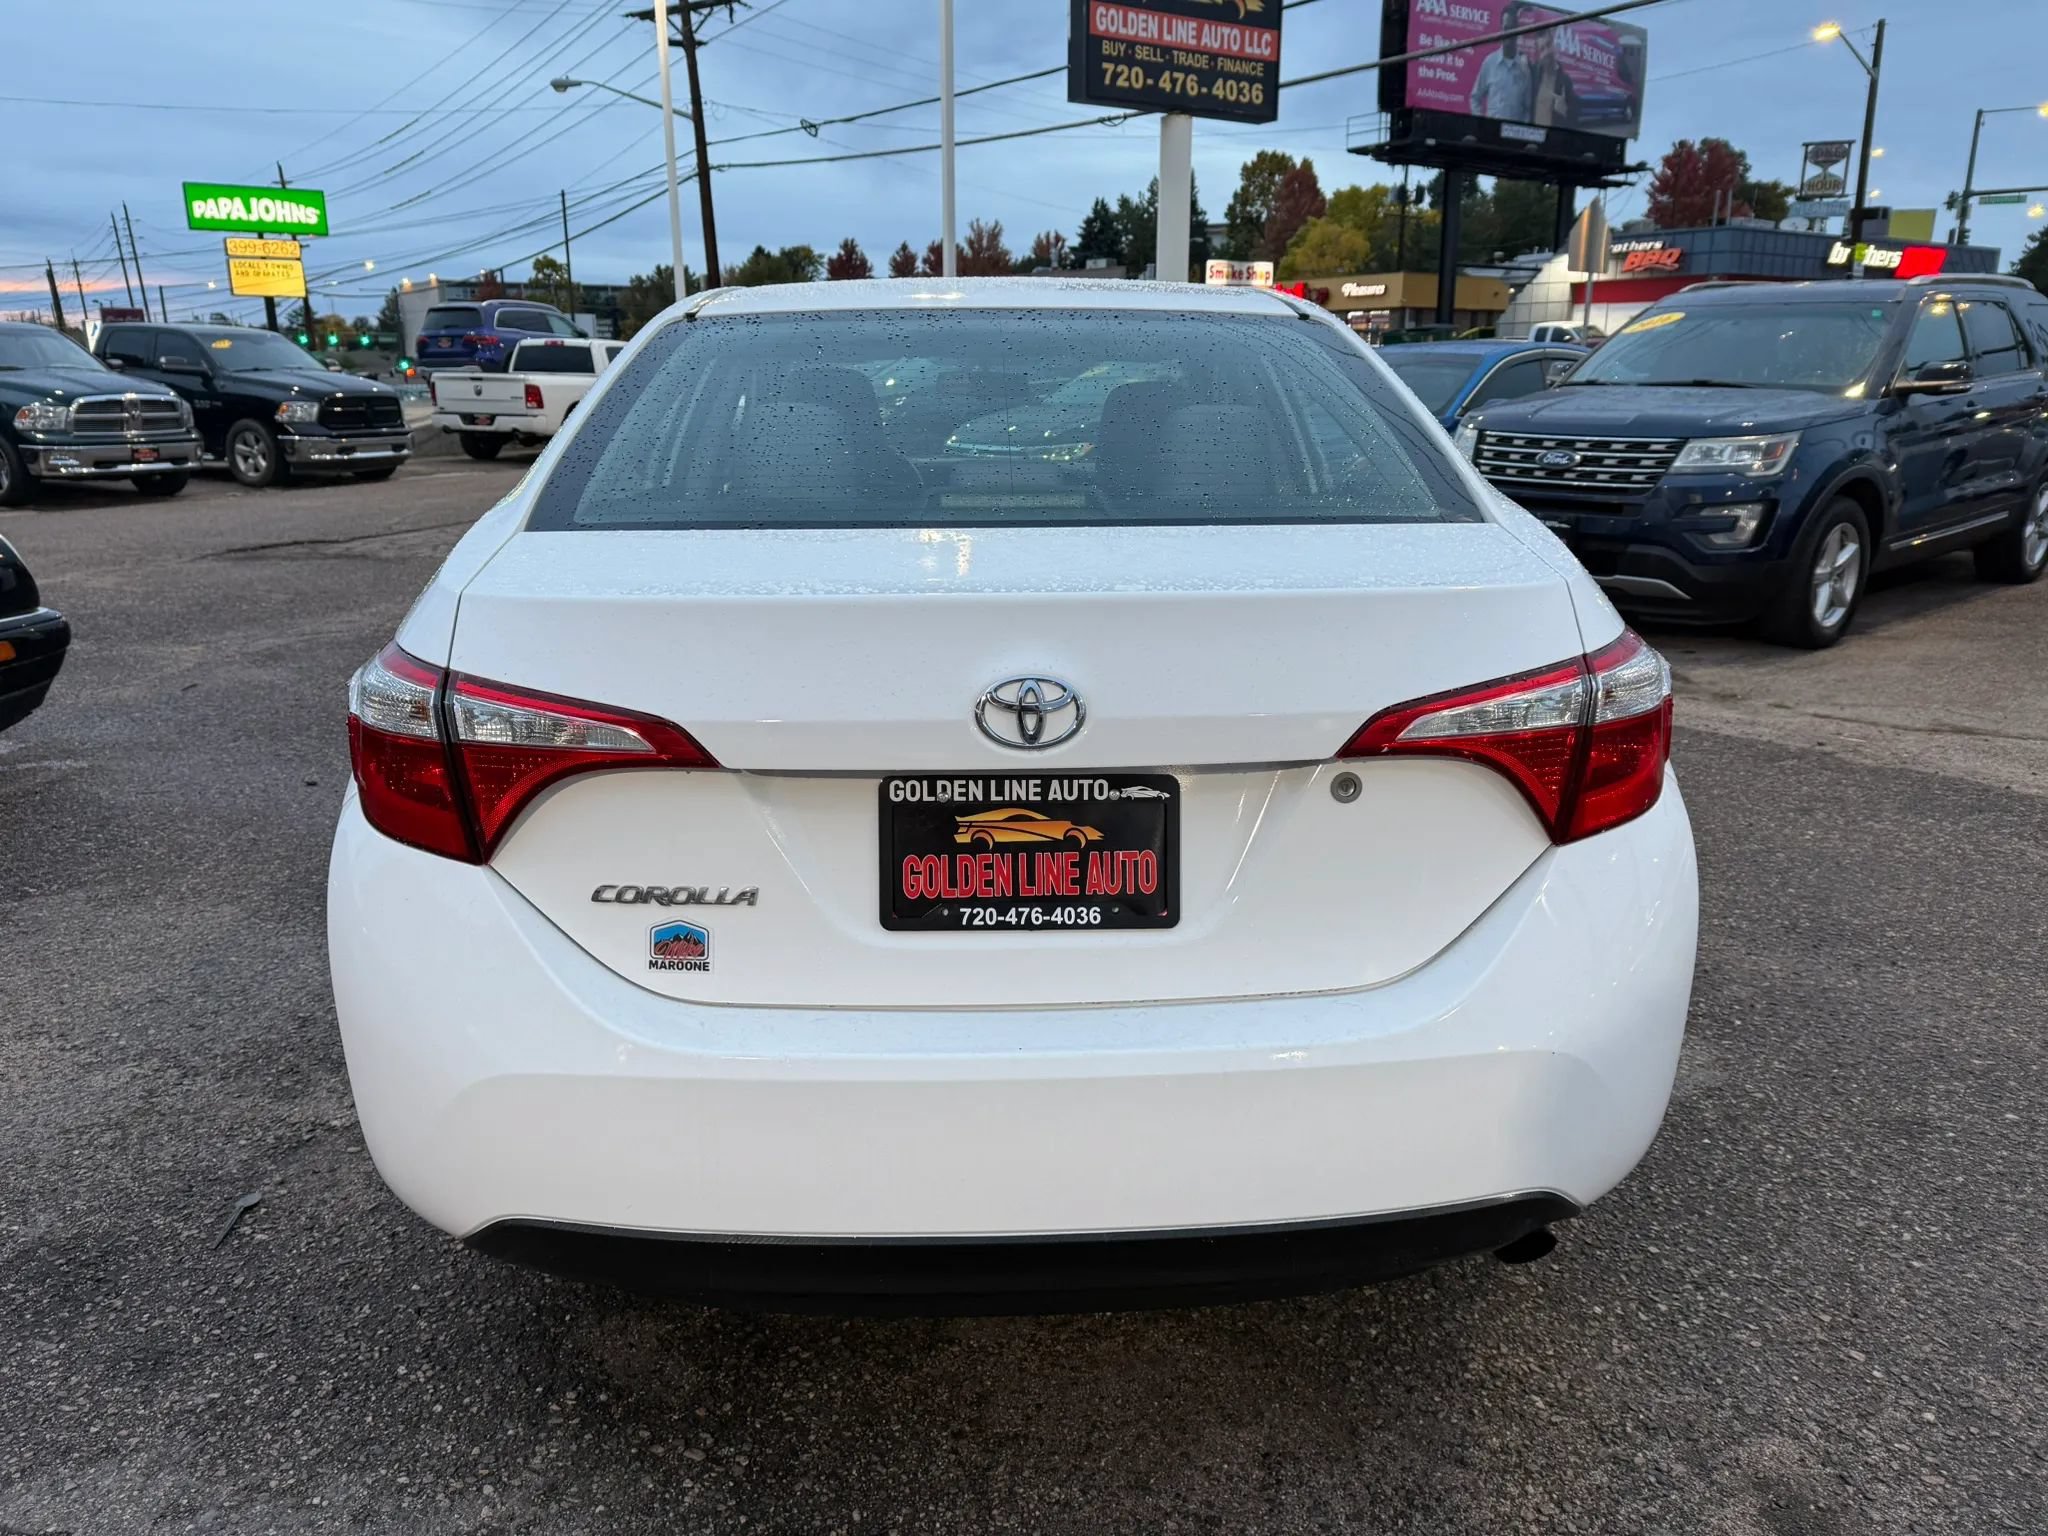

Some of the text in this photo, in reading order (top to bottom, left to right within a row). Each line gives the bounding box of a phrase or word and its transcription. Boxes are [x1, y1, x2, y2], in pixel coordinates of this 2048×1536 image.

[1450, 4, 1490, 24] SERVICE
[1096, 6, 1272, 56] GOLDEN LINE AUTO LLC
[1418, 32, 1433, 47] Be
[1554, 24, 1580, 57] AAA
[1583, 44, 1616, 69] SERVICE
[1102, 39, 1264, 77] BUY SELL TRADE FINANCE
[1455, 56, 1465, 68] to
[1418, 65, 1434, 78] the
[1101, 62, 1264, 105] 720-476-4036
[1807, 179, 1841, 193] HOUR
[192, 197, 320, 225] PAPA JOHNS
[229, 241, 298, 256] 399-6262
[1623, 248, 1681, 272] BBQ
[1209, 264, 1271, 283] Smoke Shop
[1543, 453, 1570, 464] Ford
[889, 779, 1109, 802] GOLDEN LINE AUTO
[902, 850, 1158, 899] GOLDEN LINE AUTO
[591, 885, 759, 907] COROLLA
[959, 907, 1101, 926] 720-476-4036
[649, 960, 710, 972] MAROONE
